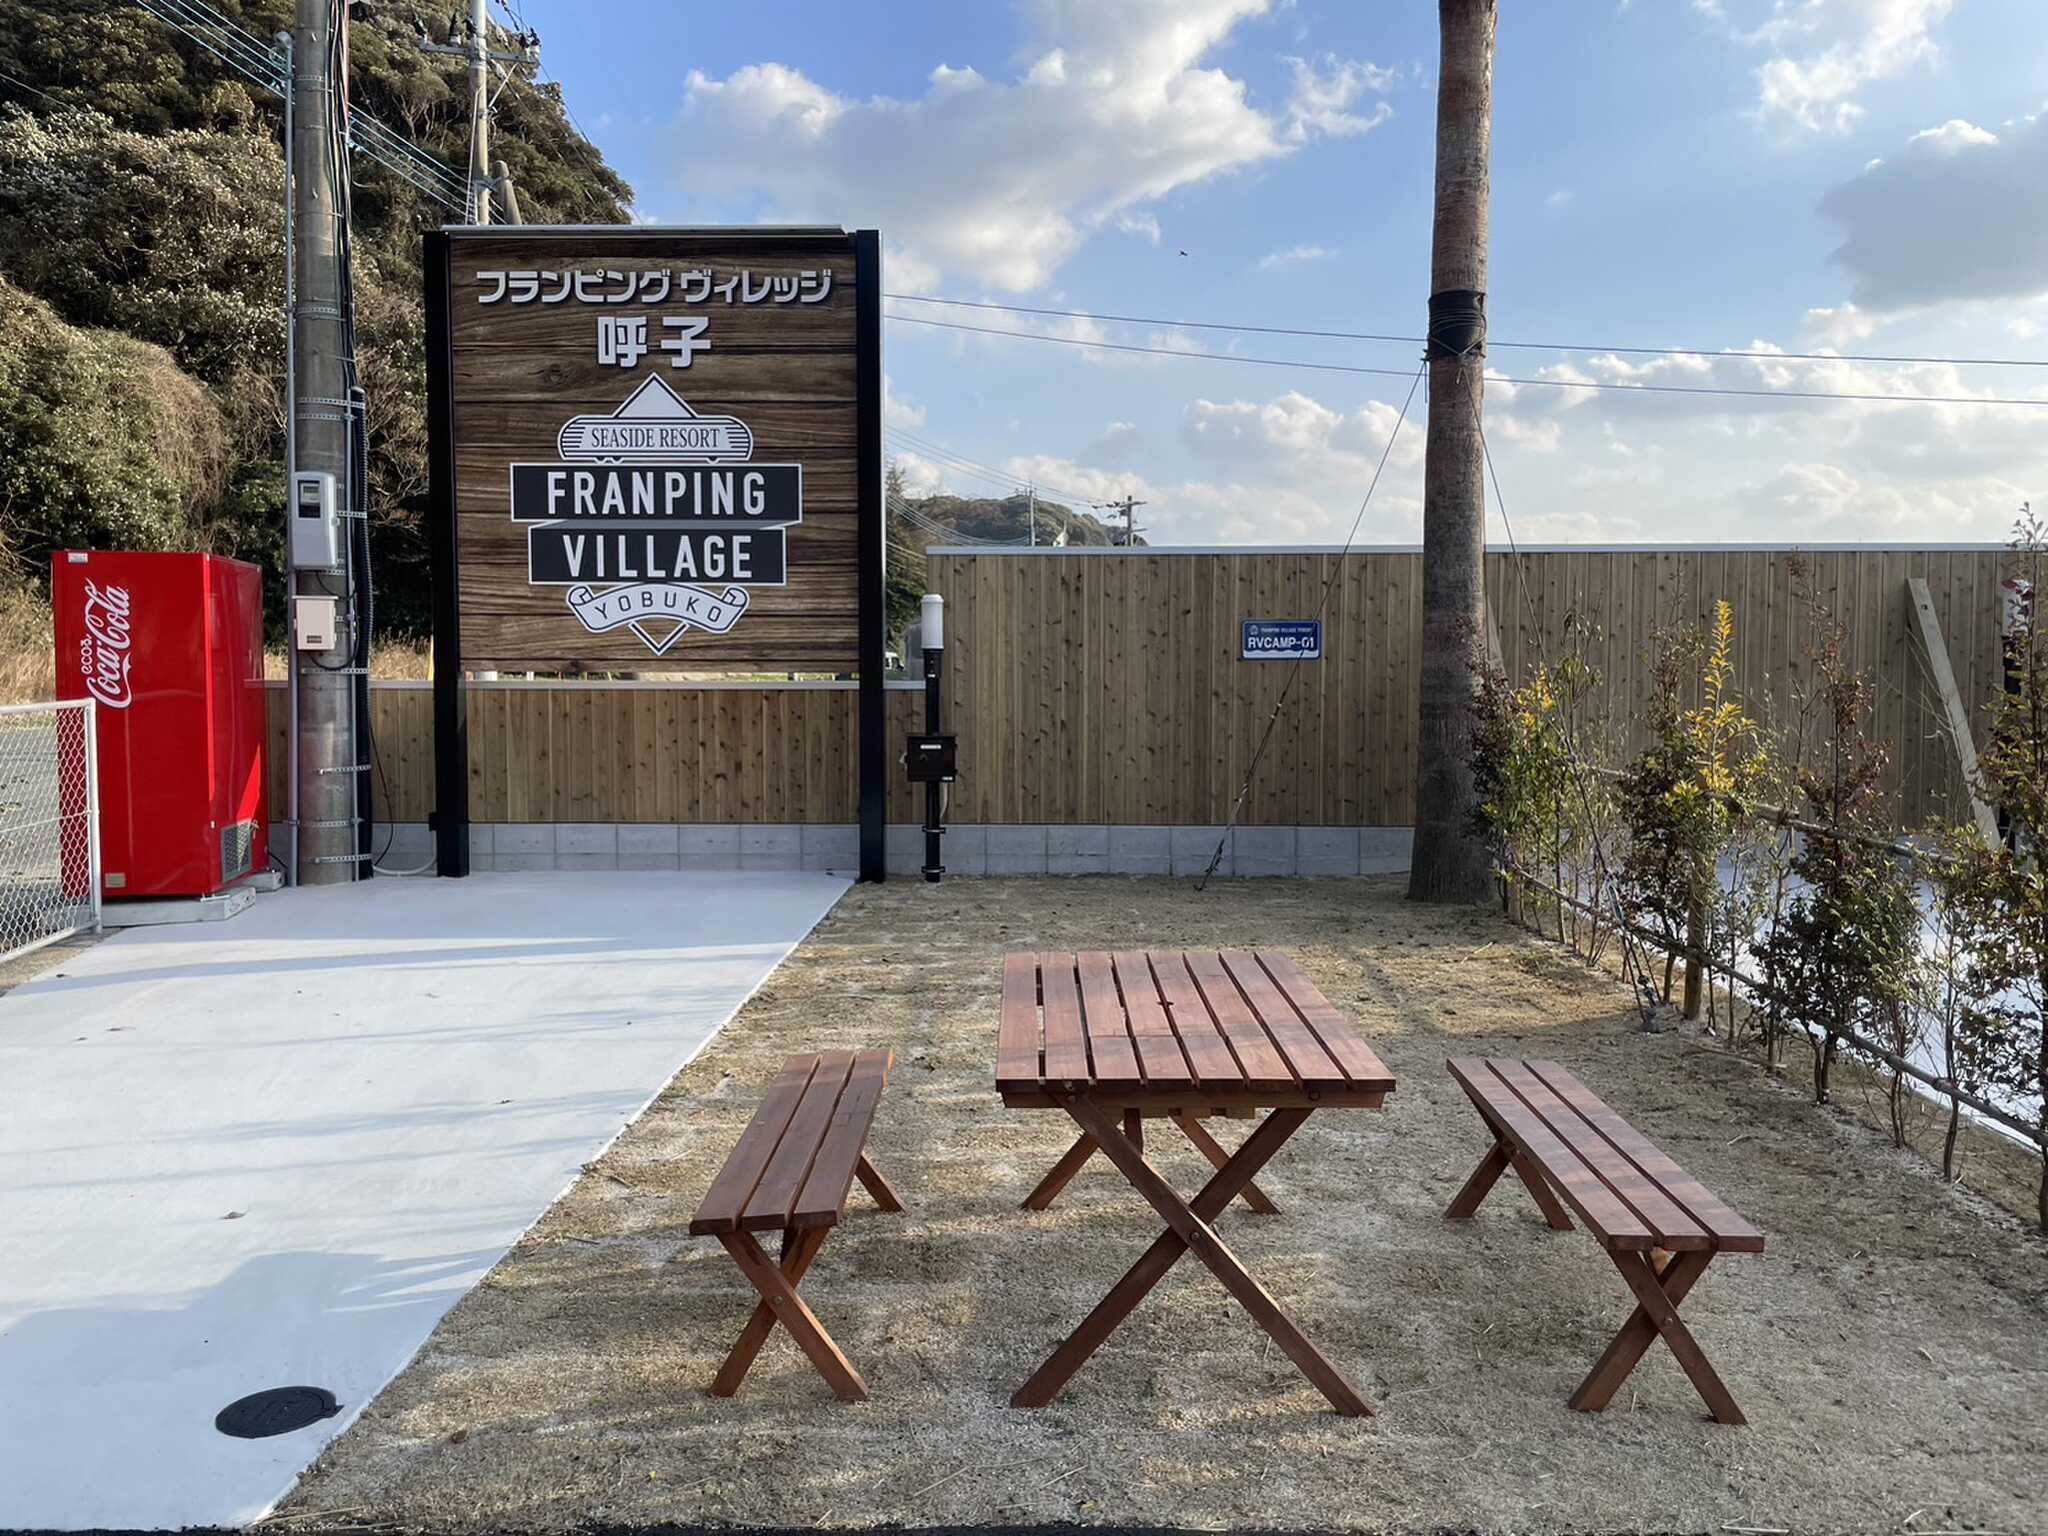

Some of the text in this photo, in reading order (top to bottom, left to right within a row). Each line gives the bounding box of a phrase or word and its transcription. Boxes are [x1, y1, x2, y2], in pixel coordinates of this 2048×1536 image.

[476, 269, 832, 303] フランピング ヴィレッジ
[597, 315, 712, 368] 呼子
[591, 427, 720, 448] SEASIDE RESORT
[546, 471, 765, 516] FRANPING
[562, 534, 753, 579] VILLAGE
[594, 590, 722, 623] YOBUKO
[1247, 636, 1315, 649] RVCAMP-01
